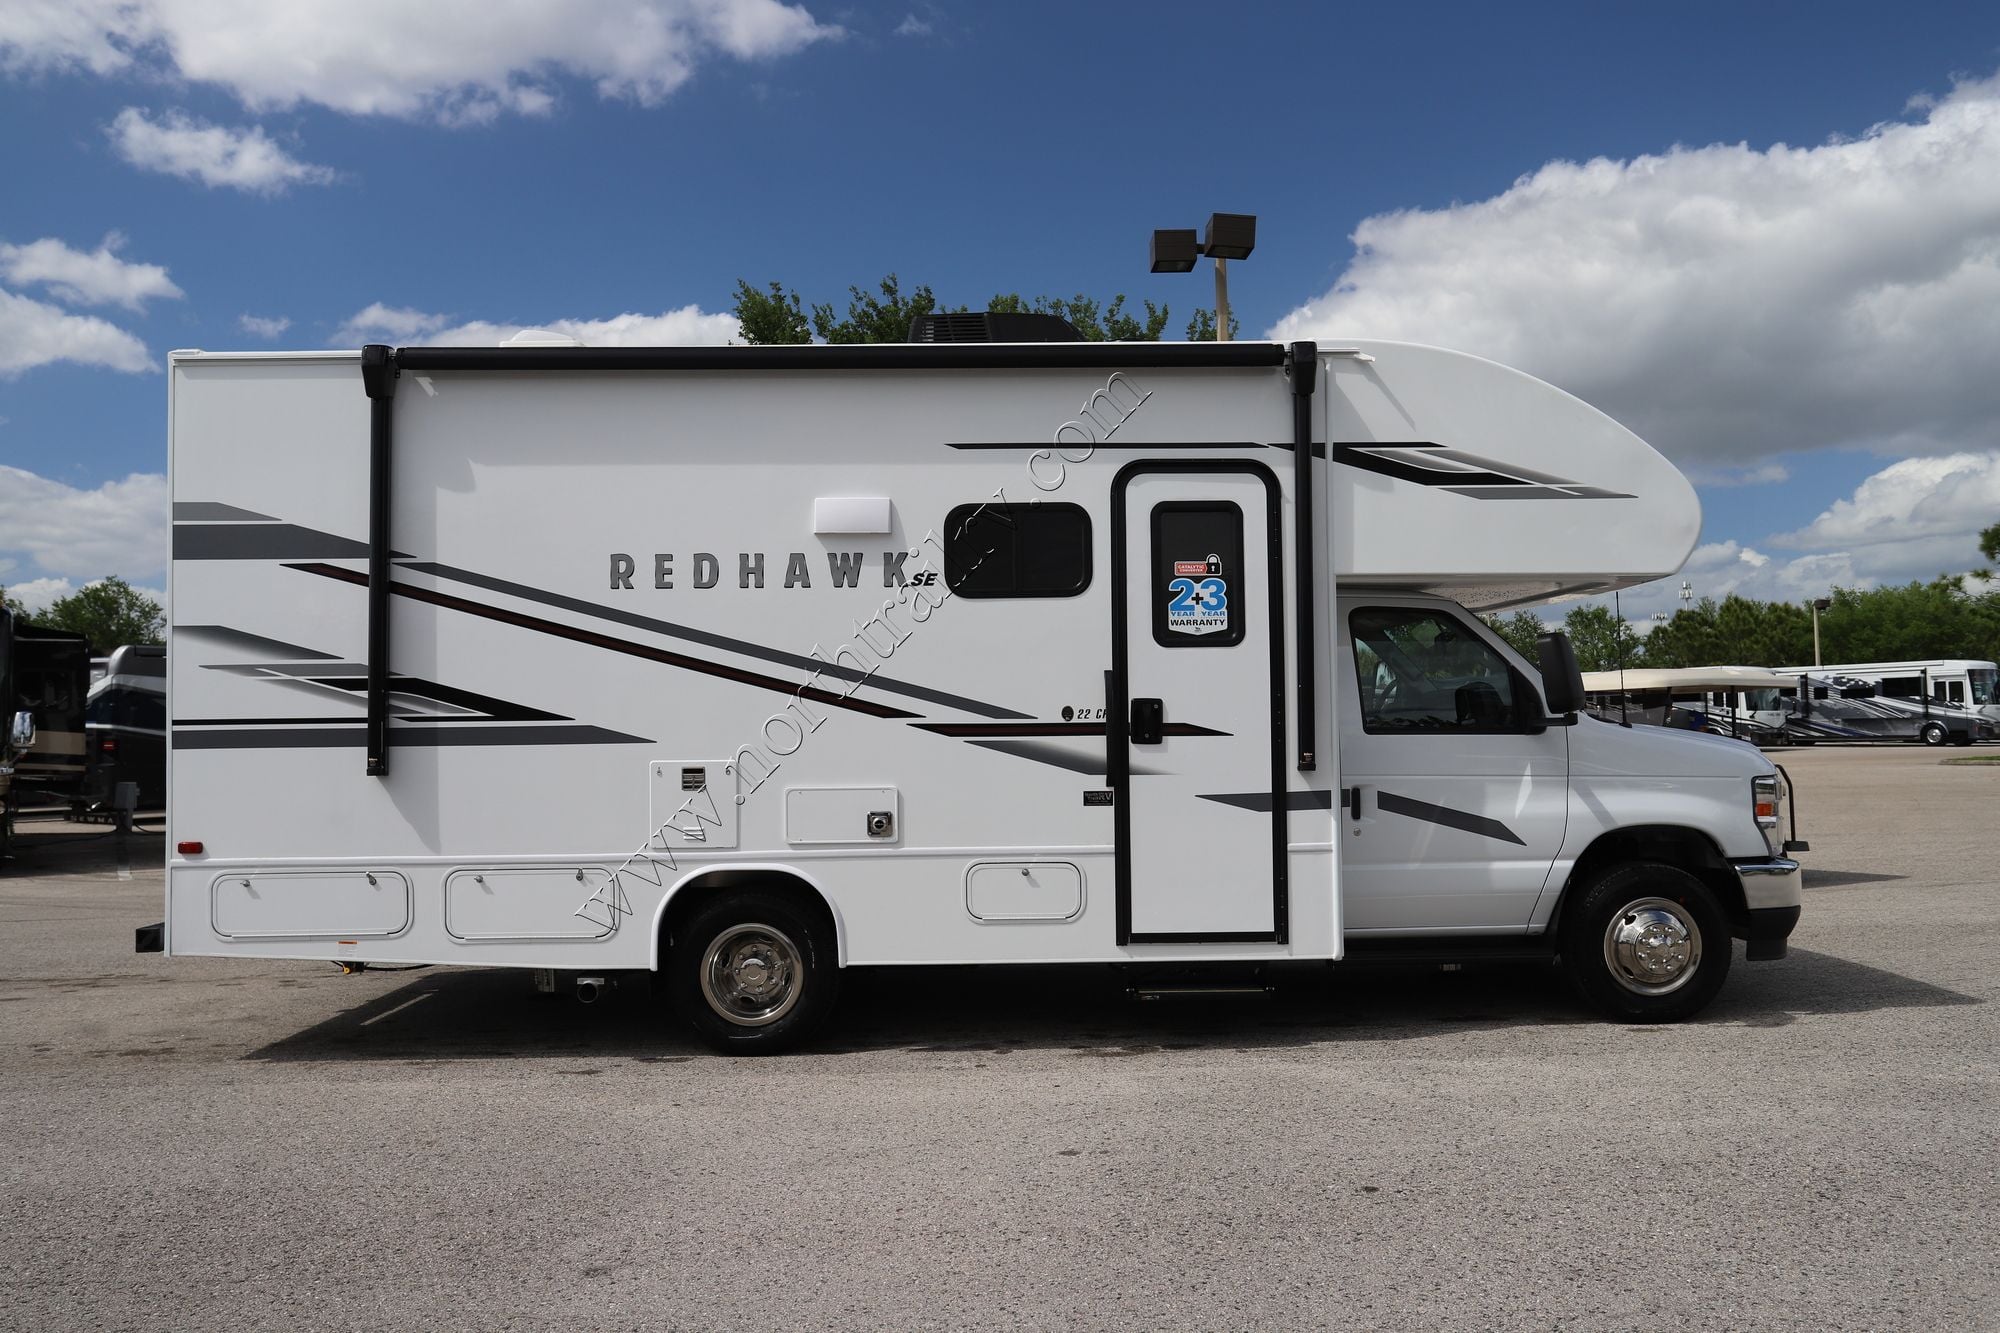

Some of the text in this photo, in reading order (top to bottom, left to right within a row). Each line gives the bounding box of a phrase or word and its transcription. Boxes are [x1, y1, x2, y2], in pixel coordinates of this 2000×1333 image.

[609, 551, 938, 590] REDHAWK SE
[1077, 708, 1091, 720] 22
[70, 815, 113, 823] NEWMA
